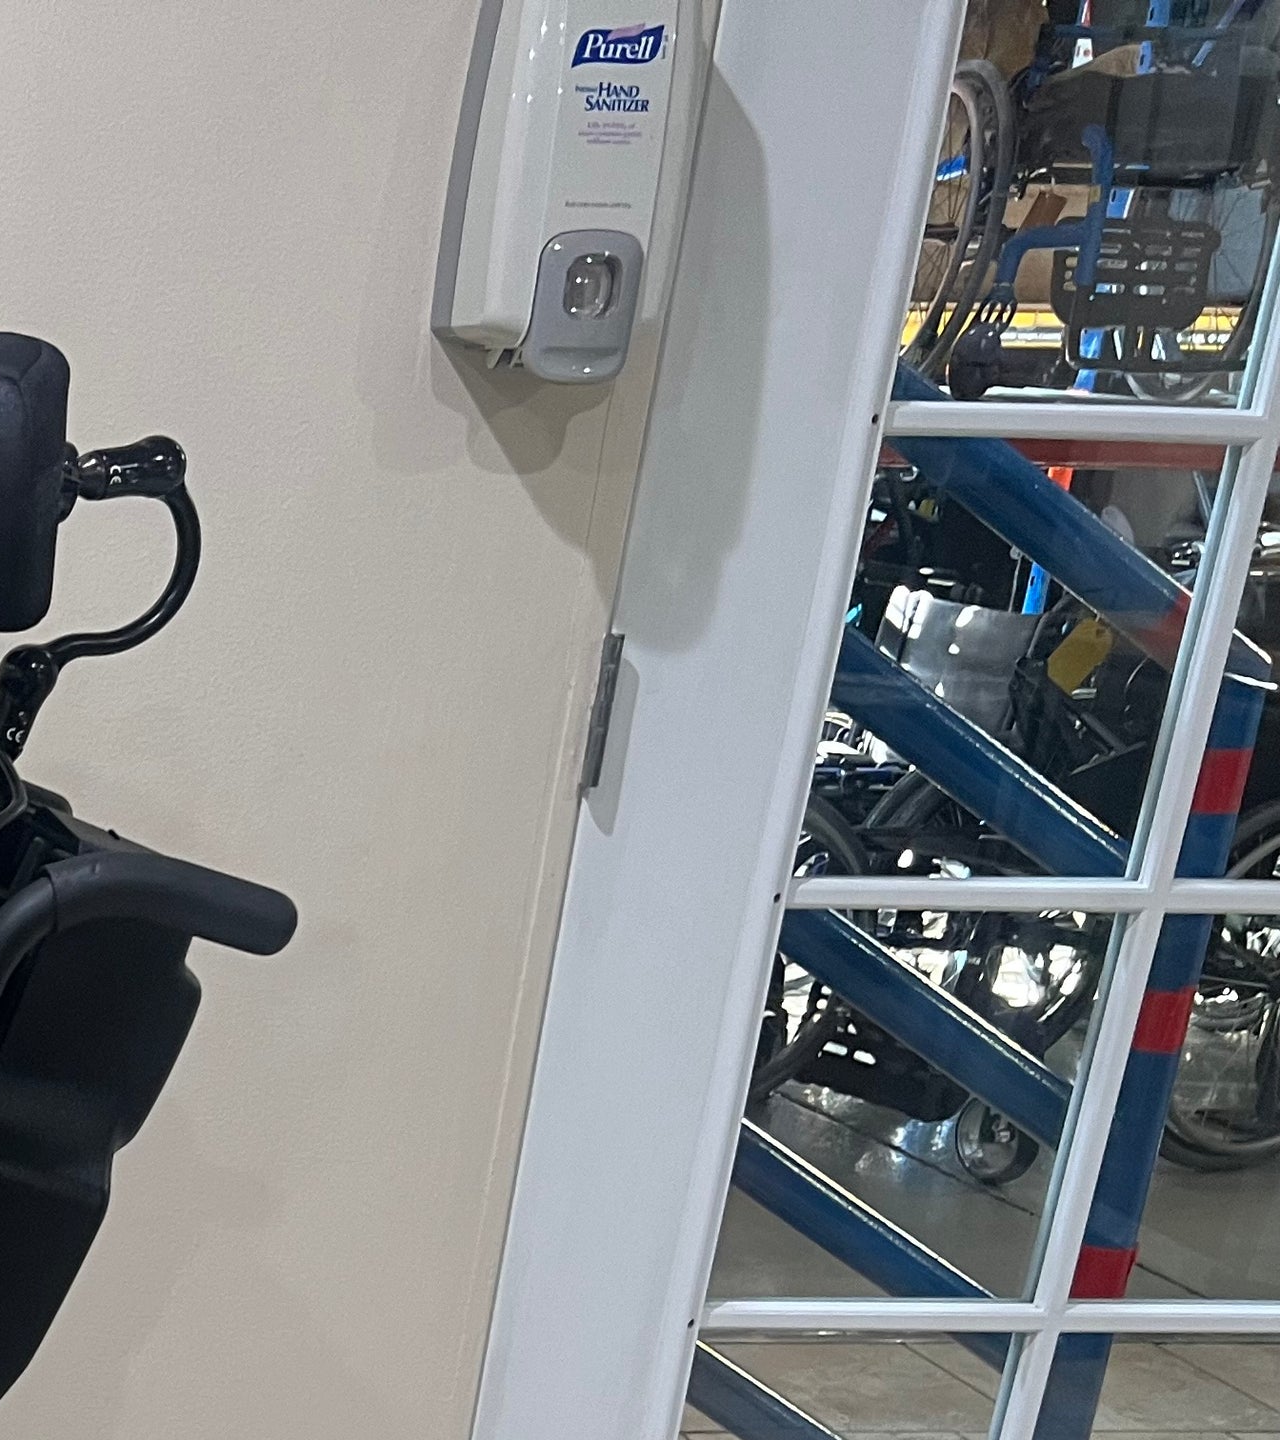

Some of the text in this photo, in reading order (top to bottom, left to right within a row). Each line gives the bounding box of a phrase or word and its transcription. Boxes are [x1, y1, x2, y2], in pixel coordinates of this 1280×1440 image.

[582, 33, 655, 60] Purell
[598, 82, 640, 98] HAND
[584, 95, 649, 112] SANITIZER
